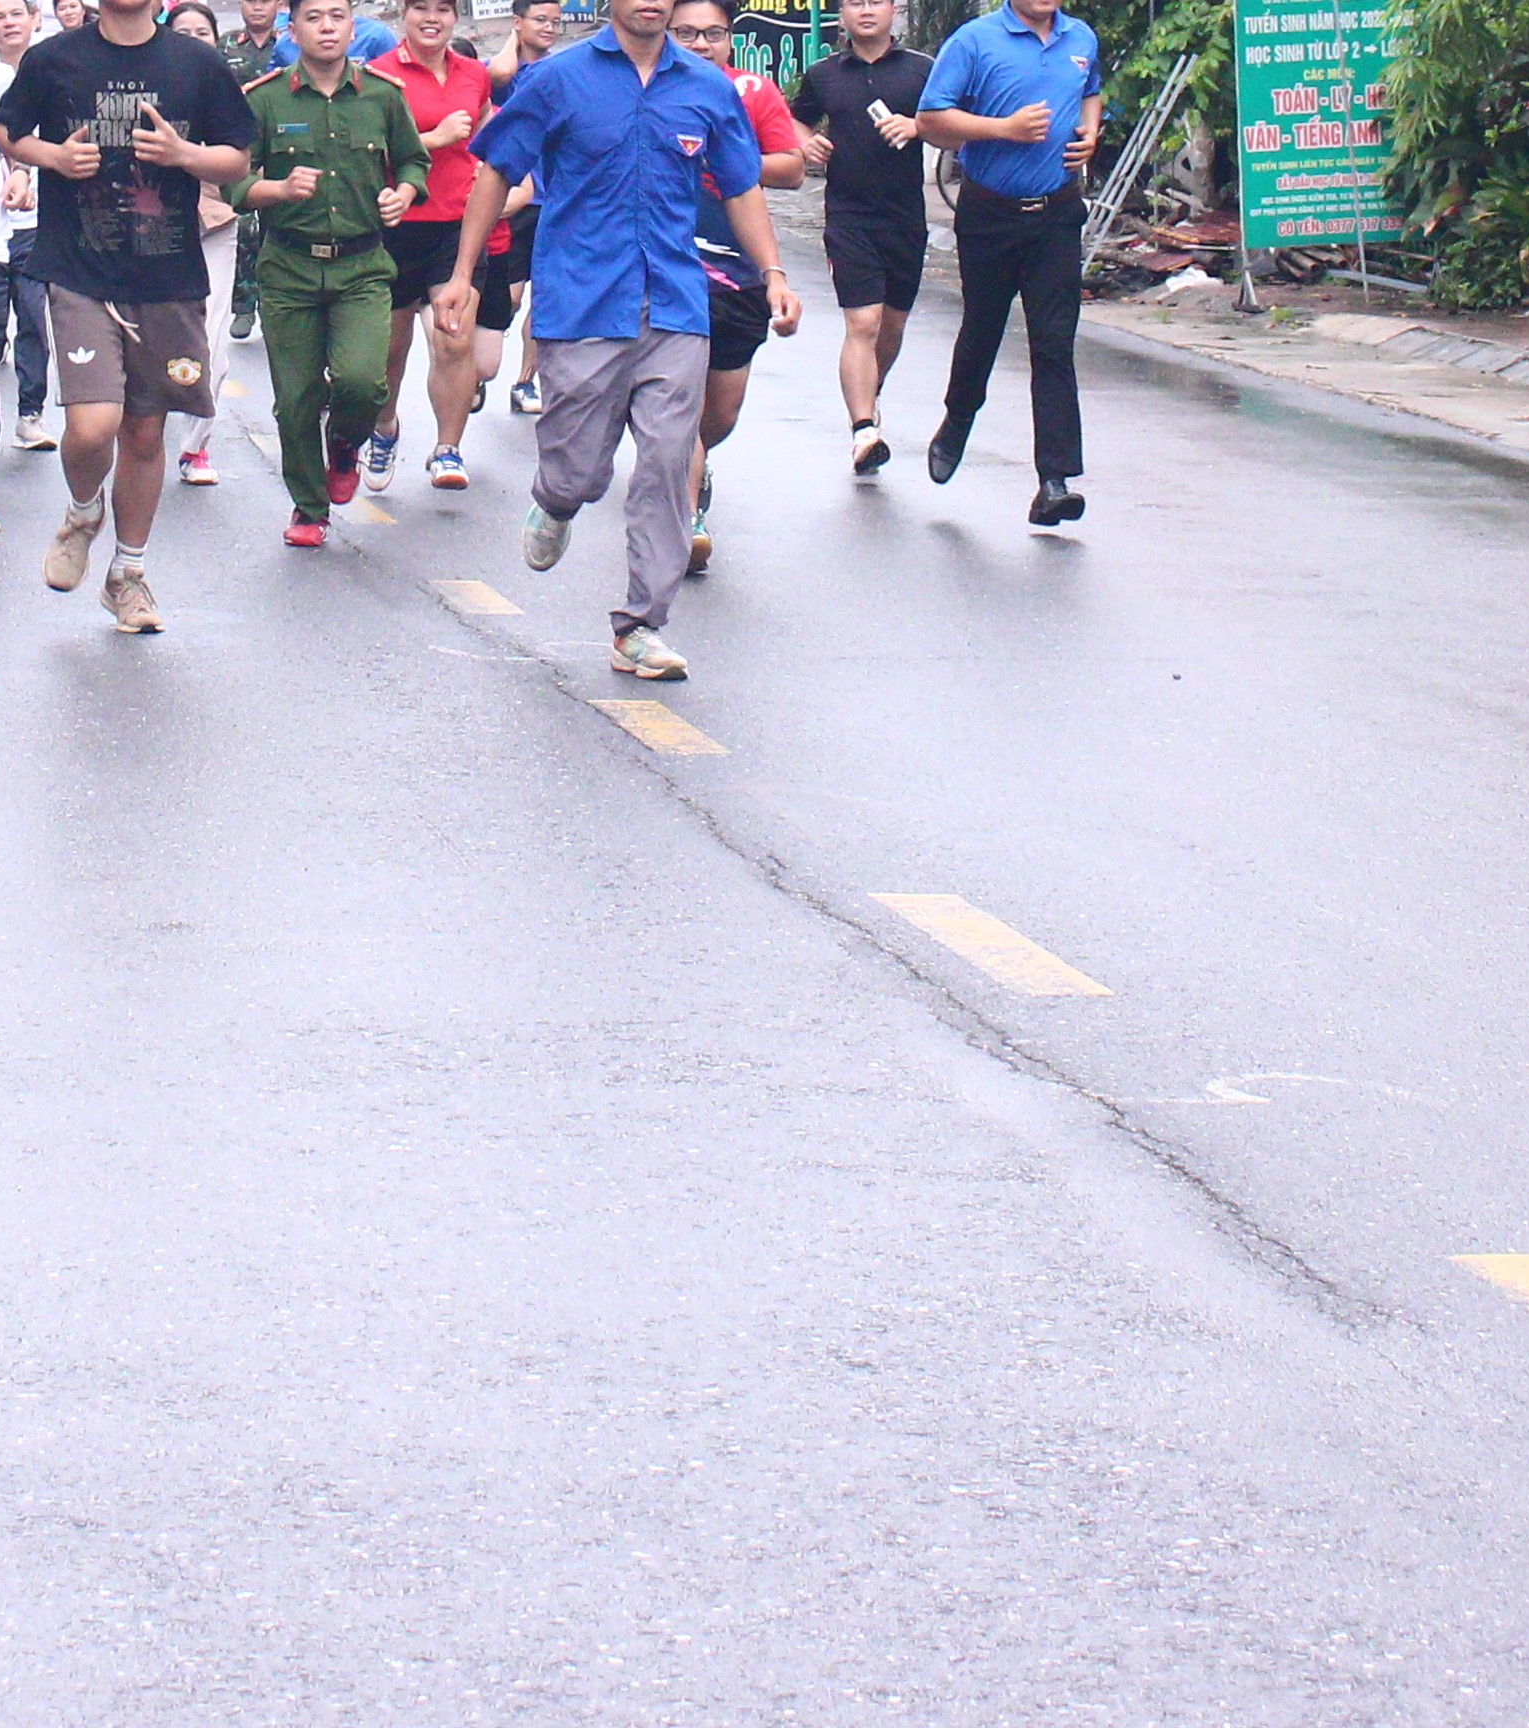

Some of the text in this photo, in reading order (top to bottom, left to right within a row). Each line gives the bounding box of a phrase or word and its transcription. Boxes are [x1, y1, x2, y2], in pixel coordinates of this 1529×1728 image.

[1244, 8, 1359, 34] TUYỂN SINH NĂM HỌC
[1245, 45, 1272, 68] HỌC
[1274, 42, 1305, 63] SINH
[1307, 39, 1325, 61] TỪ
[1351, 40, 1361, 59] 2
[1271, 82, 1319, 116] TOÁN
[1243, 114, 1382, 153] VĂN TIẾNG ANH
